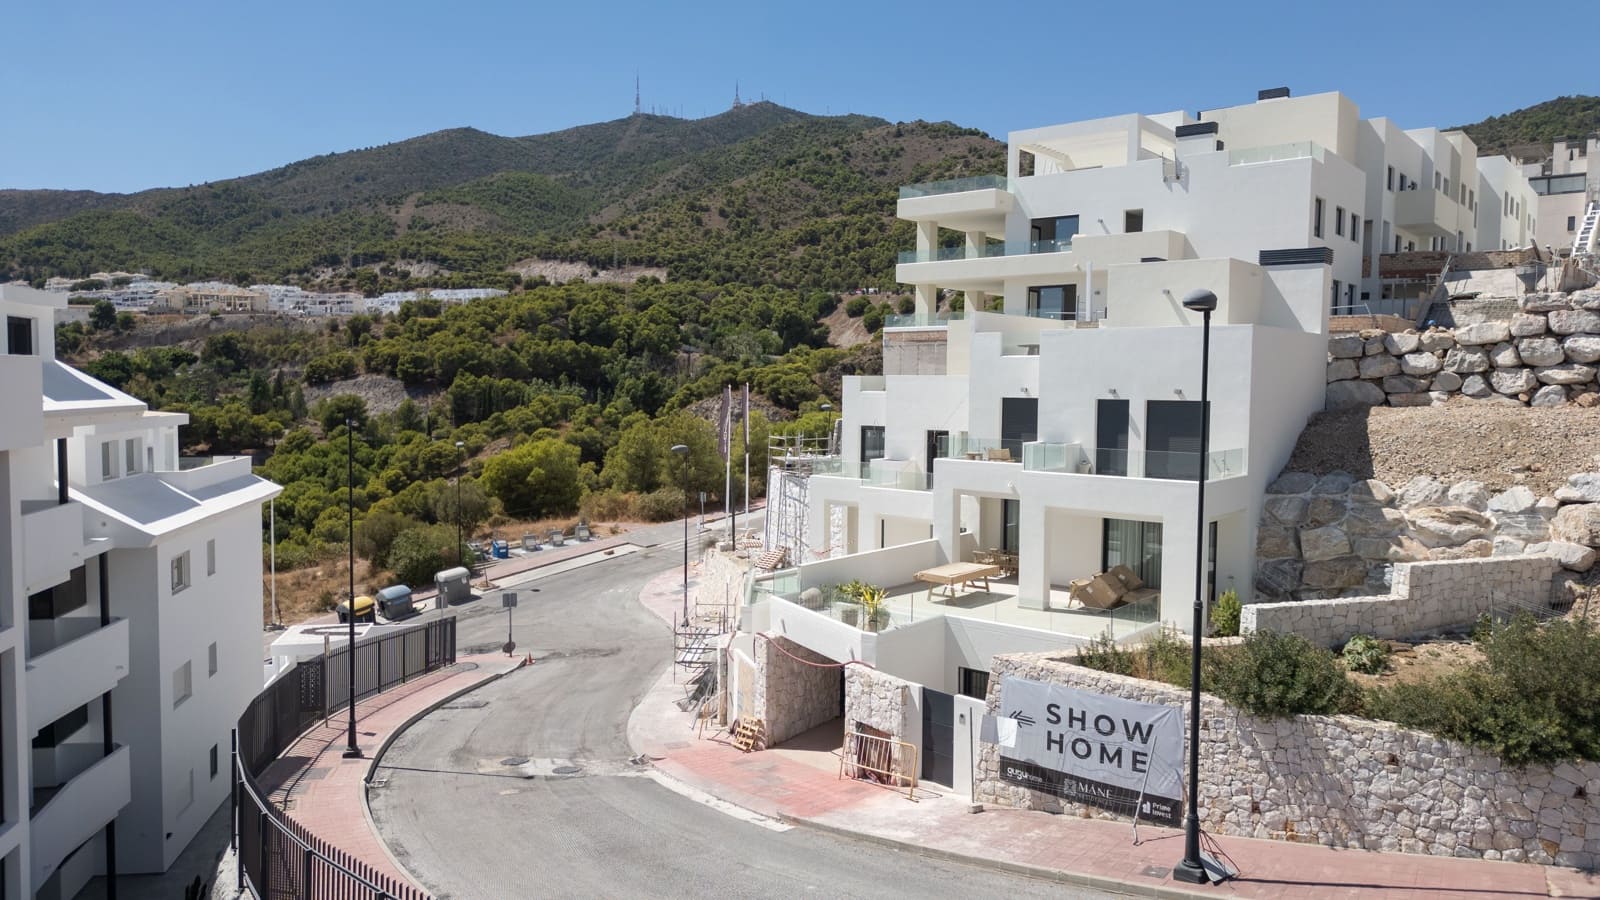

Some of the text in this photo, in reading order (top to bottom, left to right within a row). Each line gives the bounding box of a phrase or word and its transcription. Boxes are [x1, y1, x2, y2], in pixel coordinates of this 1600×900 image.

[1046, 703, 1154, 745] SHOW
[1047, 730, 1148, 773] HOME
[1152, 802, 1171, 812] Prime
